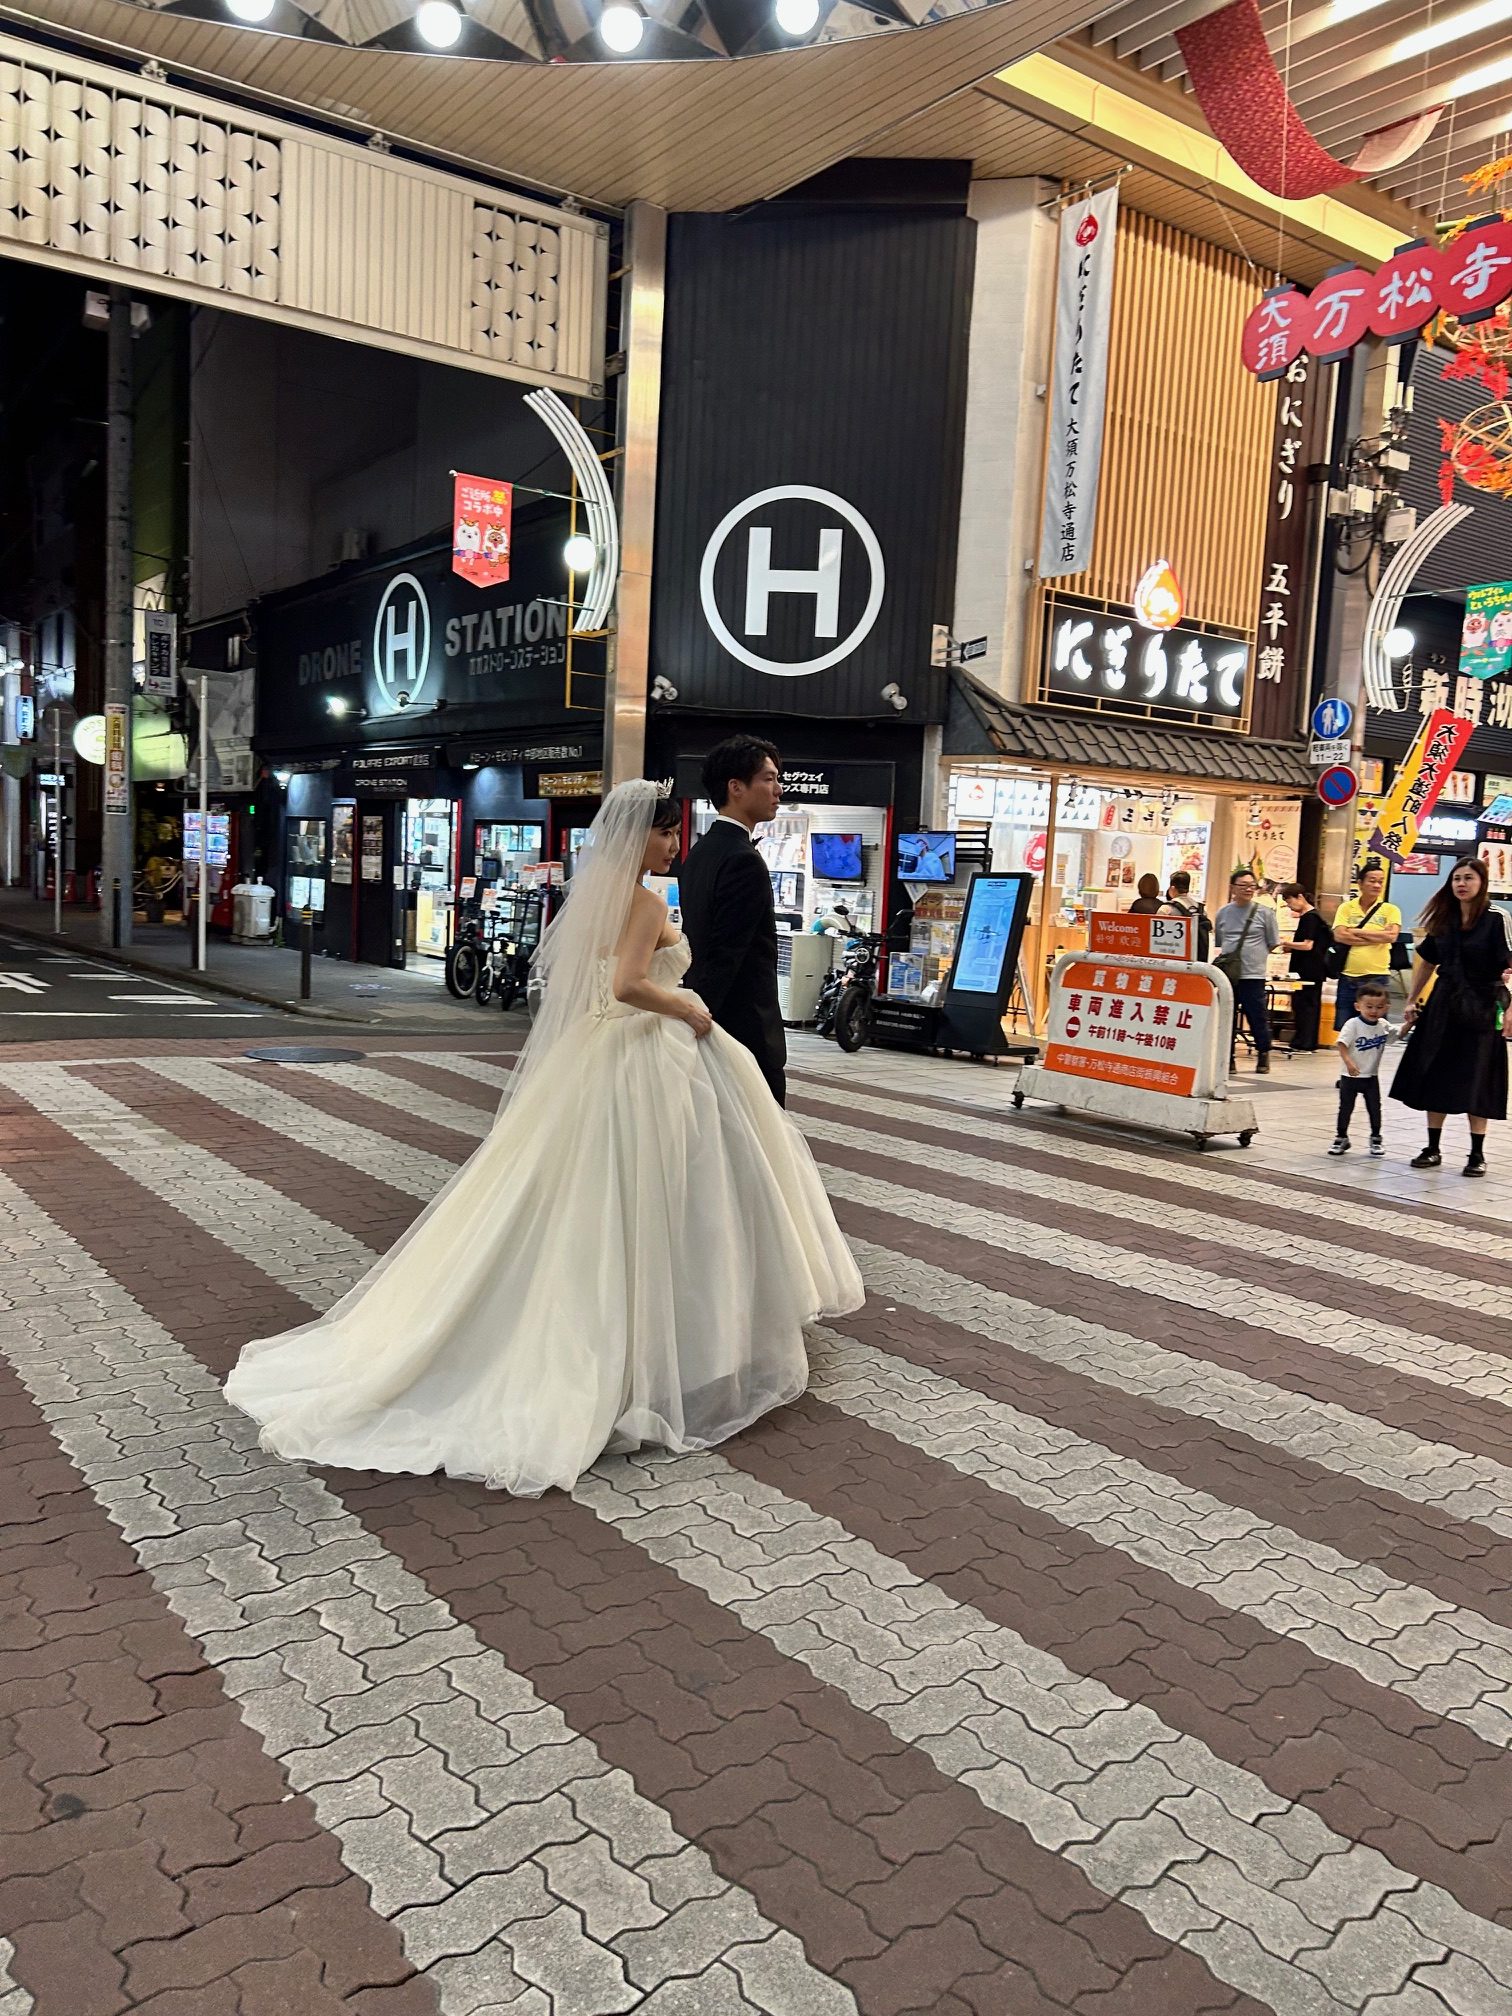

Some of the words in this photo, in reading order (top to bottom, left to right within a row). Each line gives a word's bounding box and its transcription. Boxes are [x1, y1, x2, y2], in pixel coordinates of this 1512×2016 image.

[1258, 296, 1292, 370] 大須
[1313, 242, 1512, 339] 万松寺
[1277, 353, 1309, 520] おにぎり
[1060, 417, 1080, 563] 大須万松寺通店
[299, 640, 362, 685] DRONE
[444, 596, 567, 656] STATION
[1054, 616, 1246, 708] にぎりたて
[1257, 562, 1291, 684] 五平餅
[1246, 831, 1285, 841] にぎりたて
[1097, 920, 1140, 934] Welcome
[1151, 919, 1184, 940] B-3
[1068, 993, 1194, 1030] 車両進入禁止
